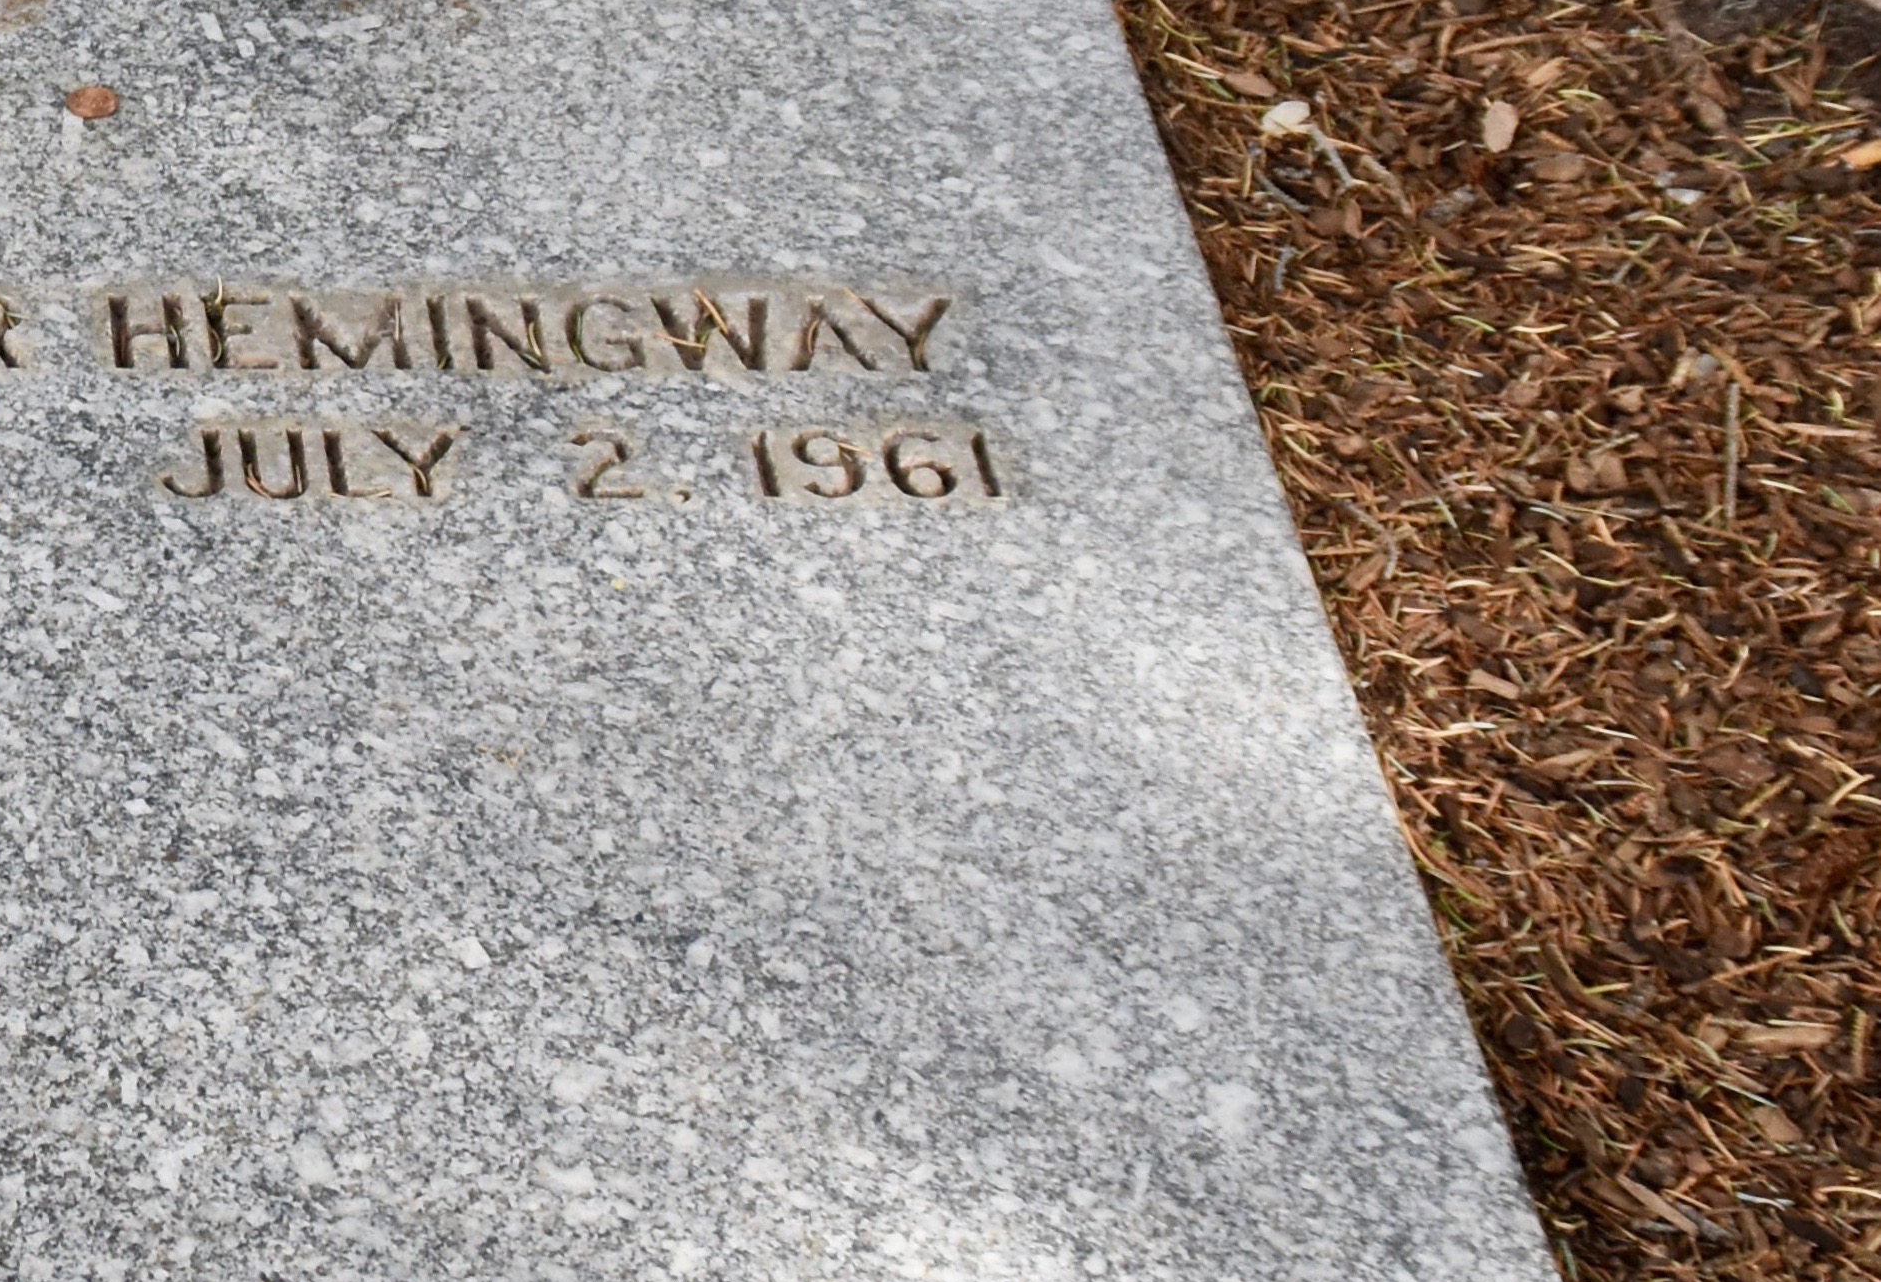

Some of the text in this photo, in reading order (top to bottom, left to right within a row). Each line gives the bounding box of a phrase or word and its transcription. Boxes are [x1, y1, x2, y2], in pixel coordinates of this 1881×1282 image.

[107, 293, 952, 372] HEMINGWAY
[162, 429, 470, 498] JULY
[751, 429, 1003, 498] 1961
